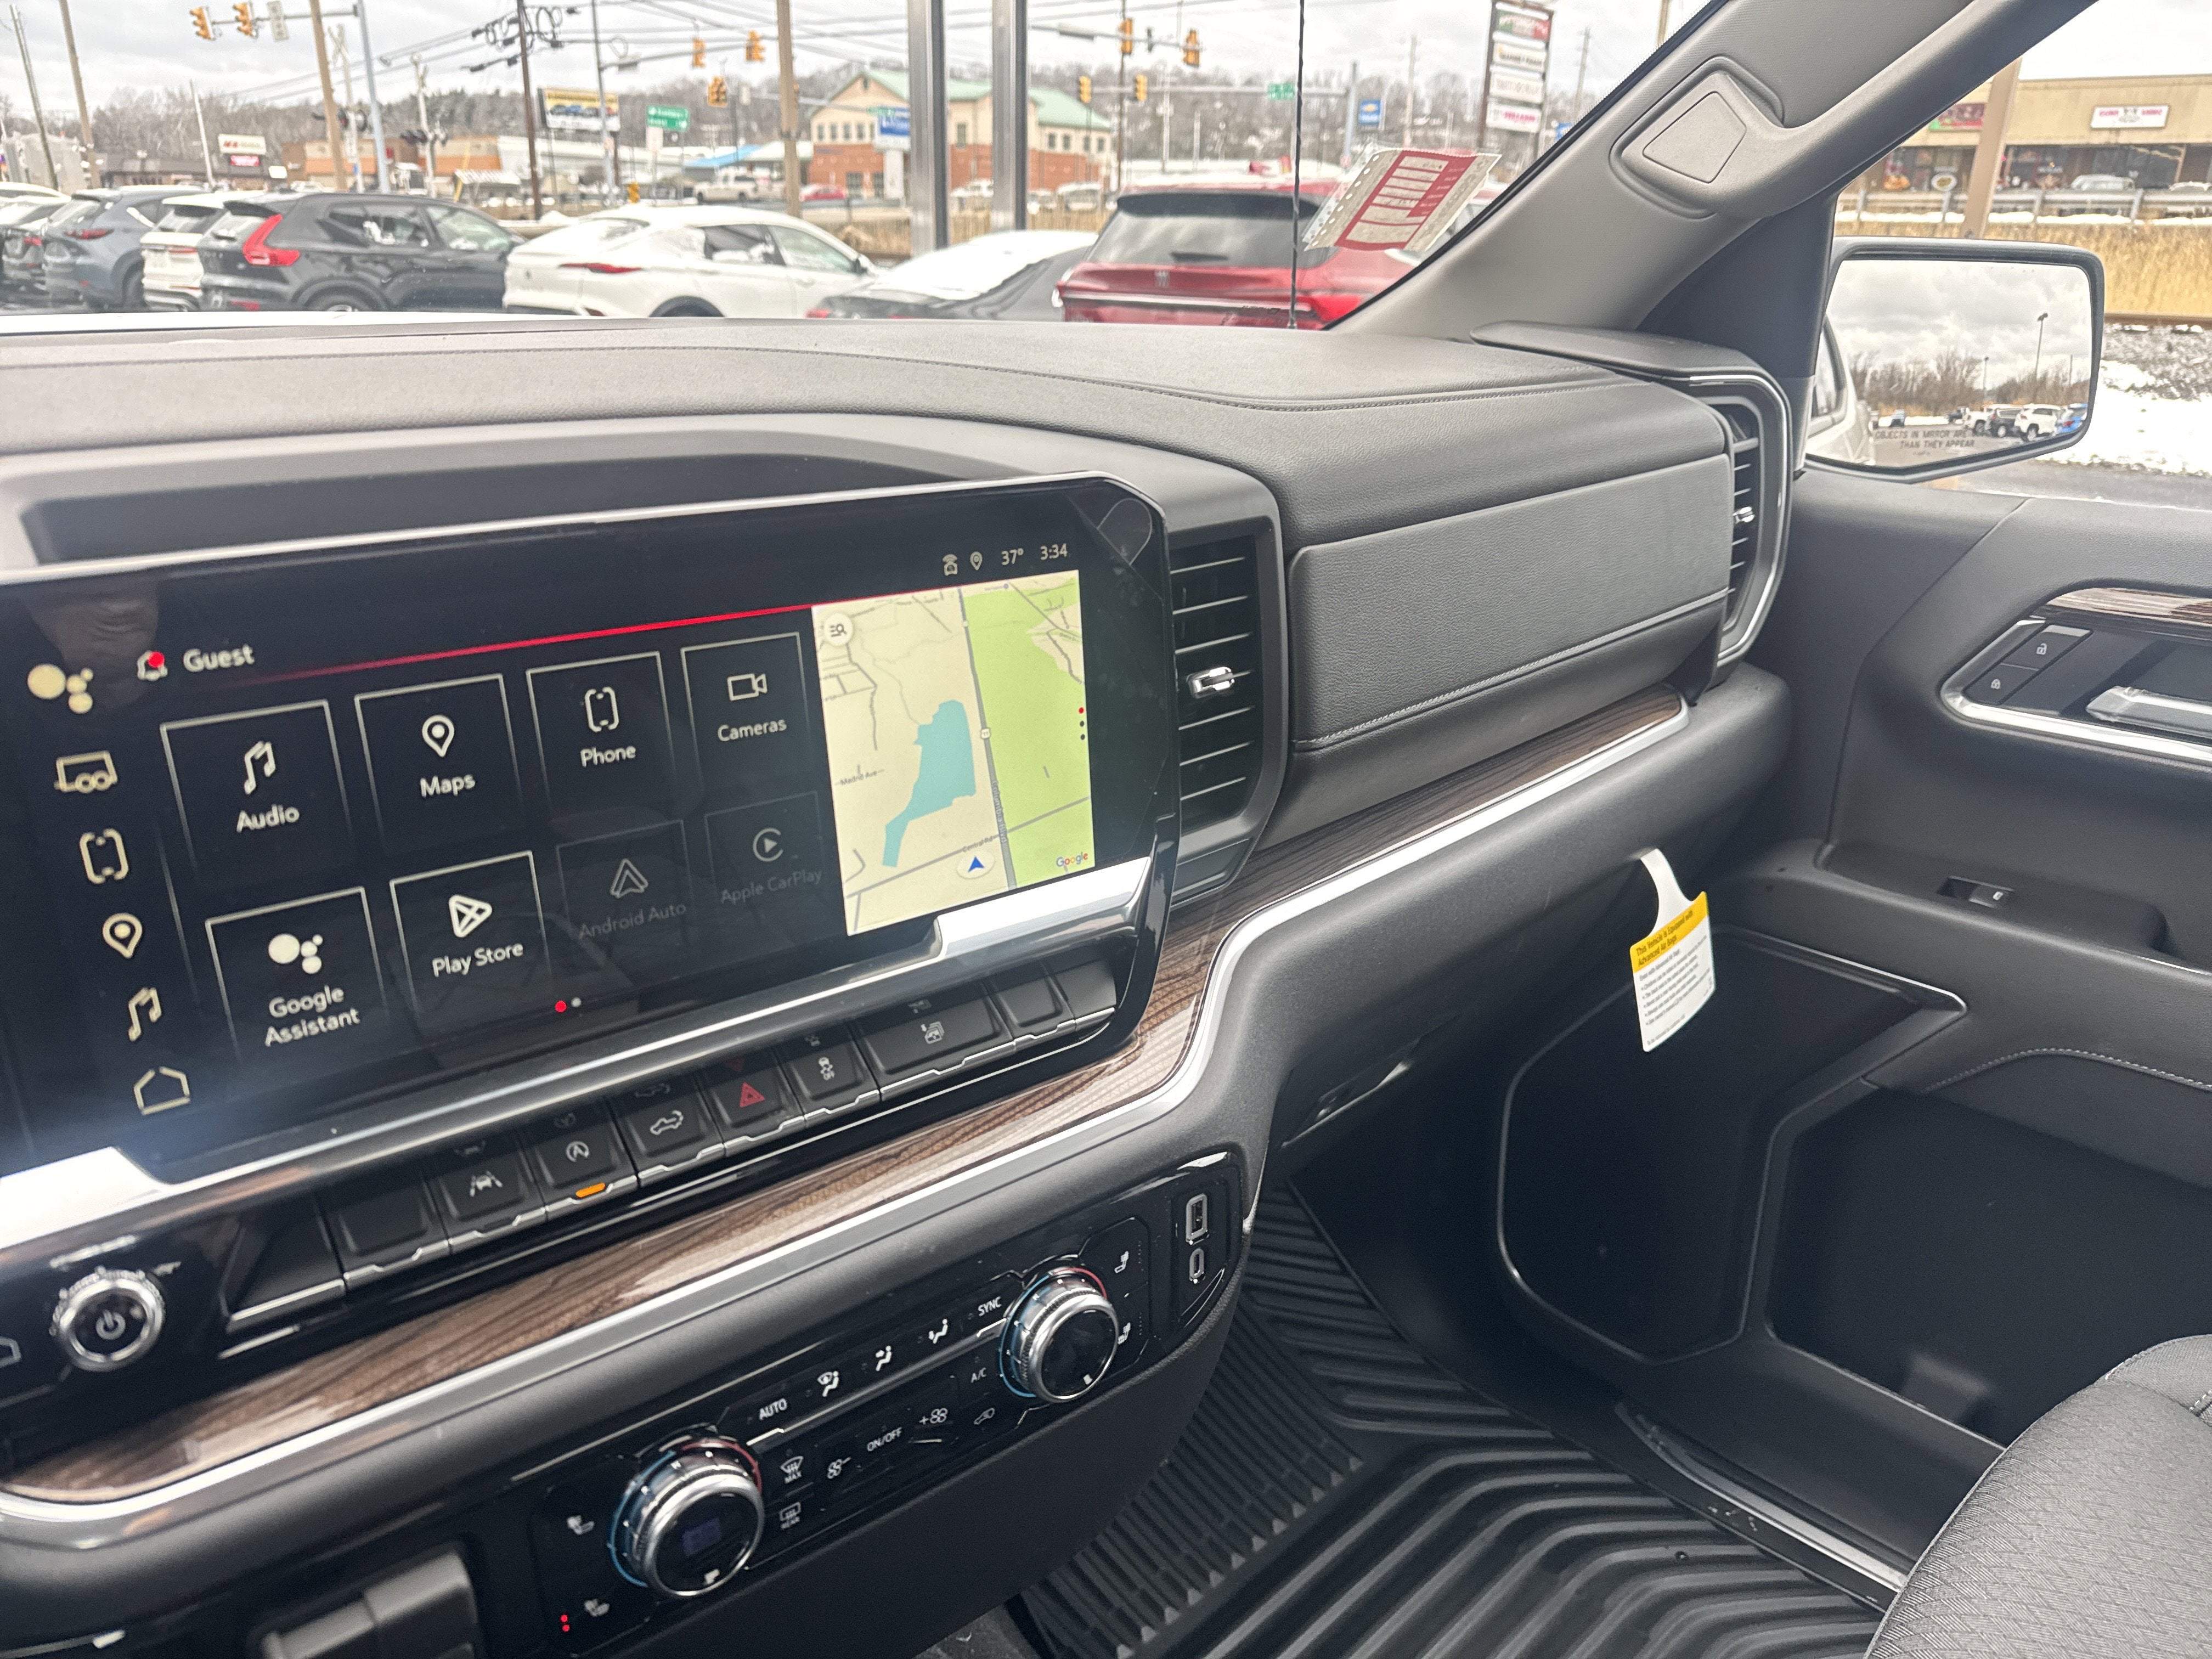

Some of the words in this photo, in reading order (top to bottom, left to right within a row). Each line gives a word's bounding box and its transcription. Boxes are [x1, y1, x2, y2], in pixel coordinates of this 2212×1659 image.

[1875, 430, 1908, 439] OBJECTS
[1911, 430, 1918, 438] IN
[1922, 429, 1949, 438] MIRROR
[1953, 430, 1967, 438] ARE
[1900, 441, 1920, 449] THAN
[1925, 440, 1942, 448] THEY
[1945, 439, 1975, 448] APPEAR
[1001, 548, 1024, 565] 37°
[1040, 543, 1068, 560] 3:34
[183, 644, 255, 672] Guest
[717, 719, 787, 742] Cameras
[580, 746, 636, 767] Phone
[420, 774, 476, 798] Maps
[992, 780, 1003, 822] Columbia
[236, 804, 300, 833] Audio
[963, 838, 984, 852] Central
[1056, 852, 1088, 867] Google
[721, 884, 764, 905] Apple
[768, 870, 821, 892] CarPlay
[578, 909, 644, 940] Android
[648, 903, 686, 922] Auto
[1636, 945, 1646, 956] This
[1647, 934, 1663, 949] Vehicle
[1667, 916, 1685, 934] Equipped
[432, 955, 471, 977] Play
[474, 943, 523, 966] Store
[1639, 946, 1660, 967] Advanced
[269, 984, 344, 1018] Google
[264, 1007, 360, 1047] Assistant
[978, 1296, 1002, 1317] SYNC
[970, 1367, 987, 1383] A/C
[759, 1398, 787, 1420] AUTO
[867, 1427, 902, 1452] ON/OFF
[785, 1471, 802, 1484] MAX
